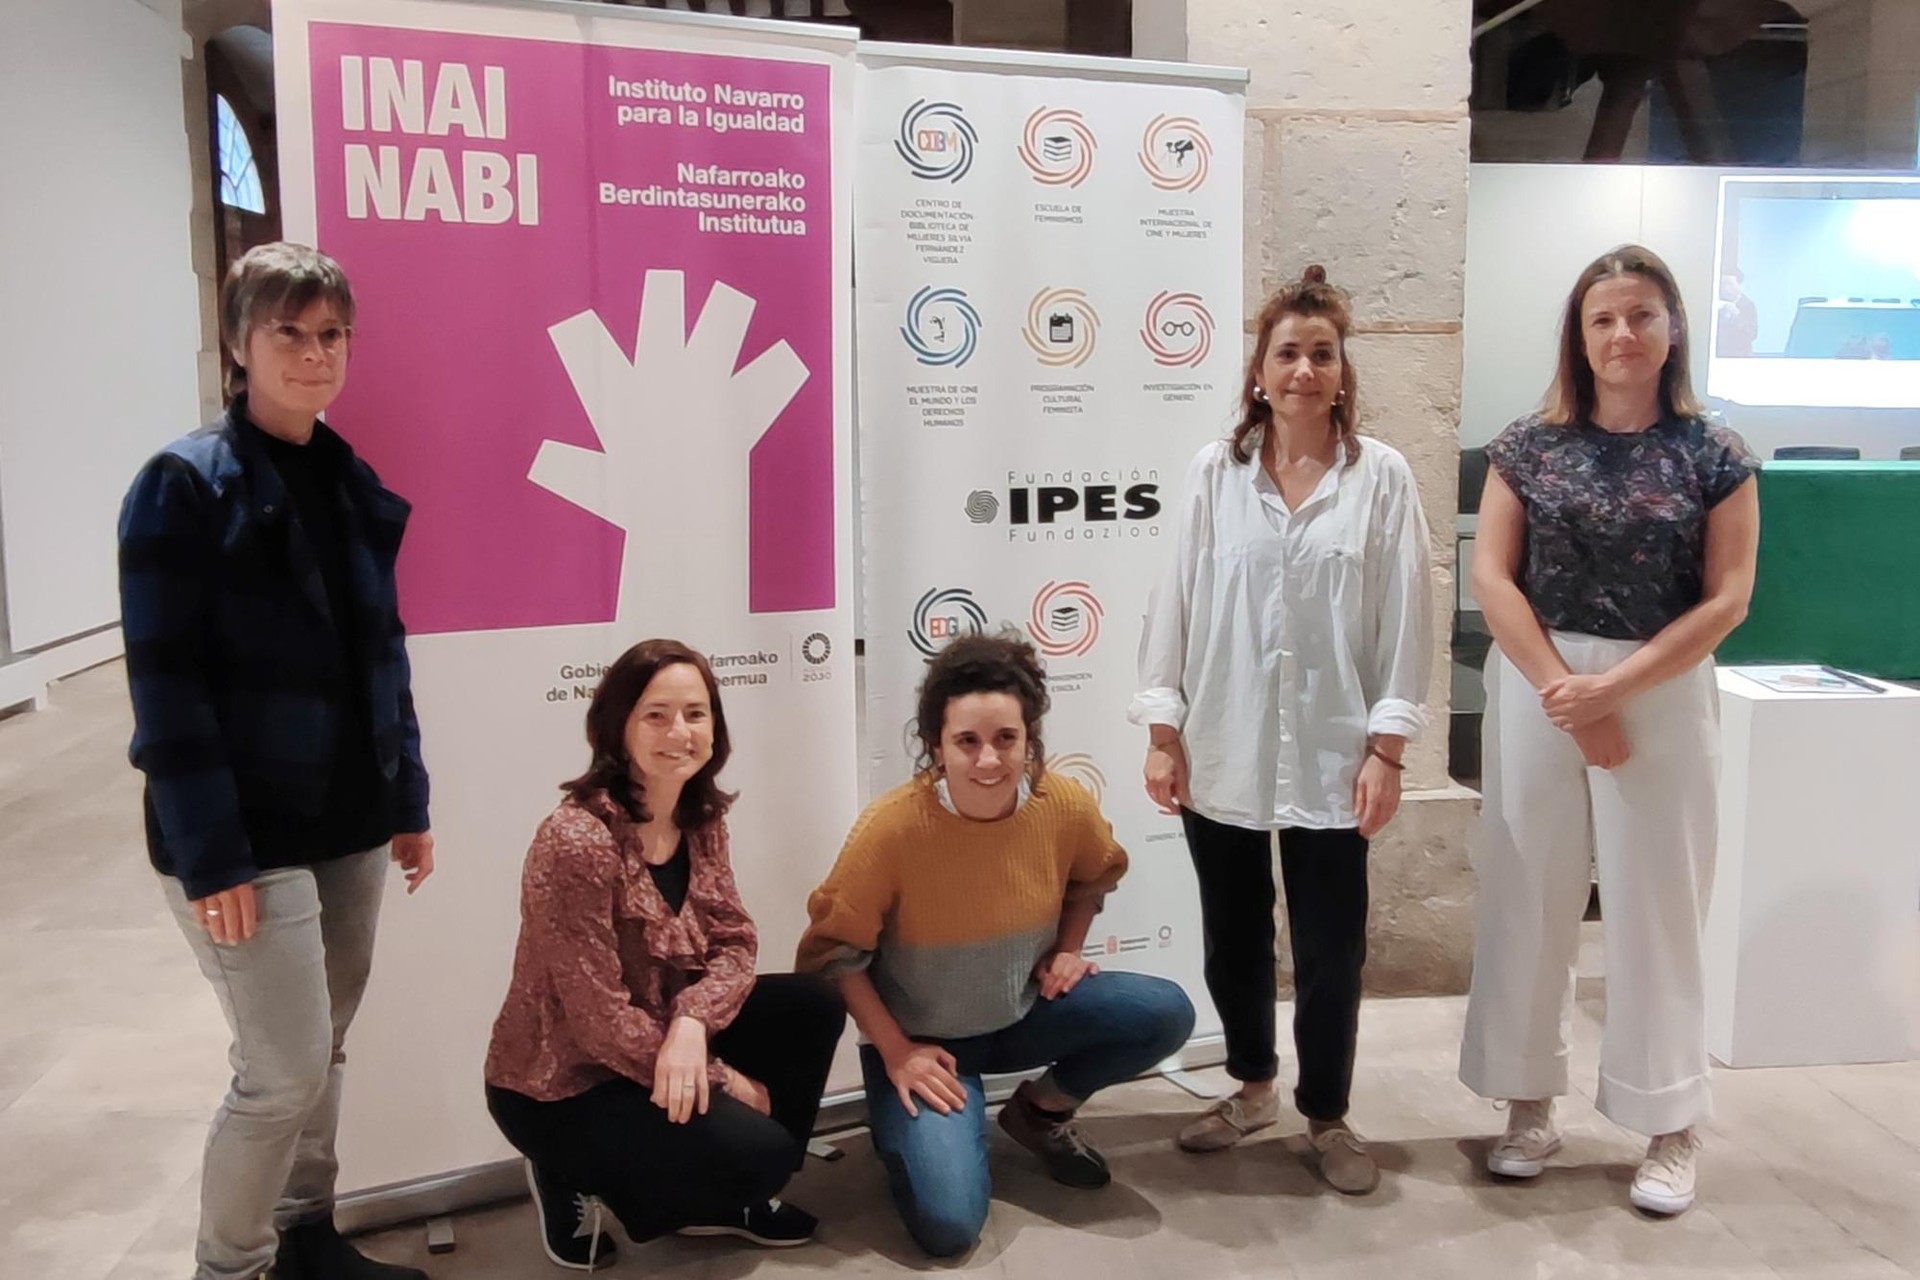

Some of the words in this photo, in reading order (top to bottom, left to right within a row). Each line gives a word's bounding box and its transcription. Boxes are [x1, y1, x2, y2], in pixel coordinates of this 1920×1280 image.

[340, 54, 507, 140] INAI
[608, 75, 707, 103] Instituto
[714, 83, 805, 110] Navarro
[617, 104, 672, 126] para
[678, 105, 699, 126] la
[705, 107, 805, 133] Igualdad
[344, 143, 540, 226] NABI
[677, 162, 806, 190] Nafarroako
[599, 182, 806, 212] Berdintasunerako
[915, 199, 949, 208] CENTRO
[699, 210, 806, 235] Institutua
[906, 385, 947, 394] MUESTRA
[1008, 467, 1158, 485] Fundación
[1009, 483, 1161, 525] IPES
[1009, 525, 1160, 542] Fundazioa
[709, 650, 779, 668] farroako
[560, 662, 613, 680] Gobie
[713, 673, 768, 687] ernua
[546, 686, 568, 702] de
